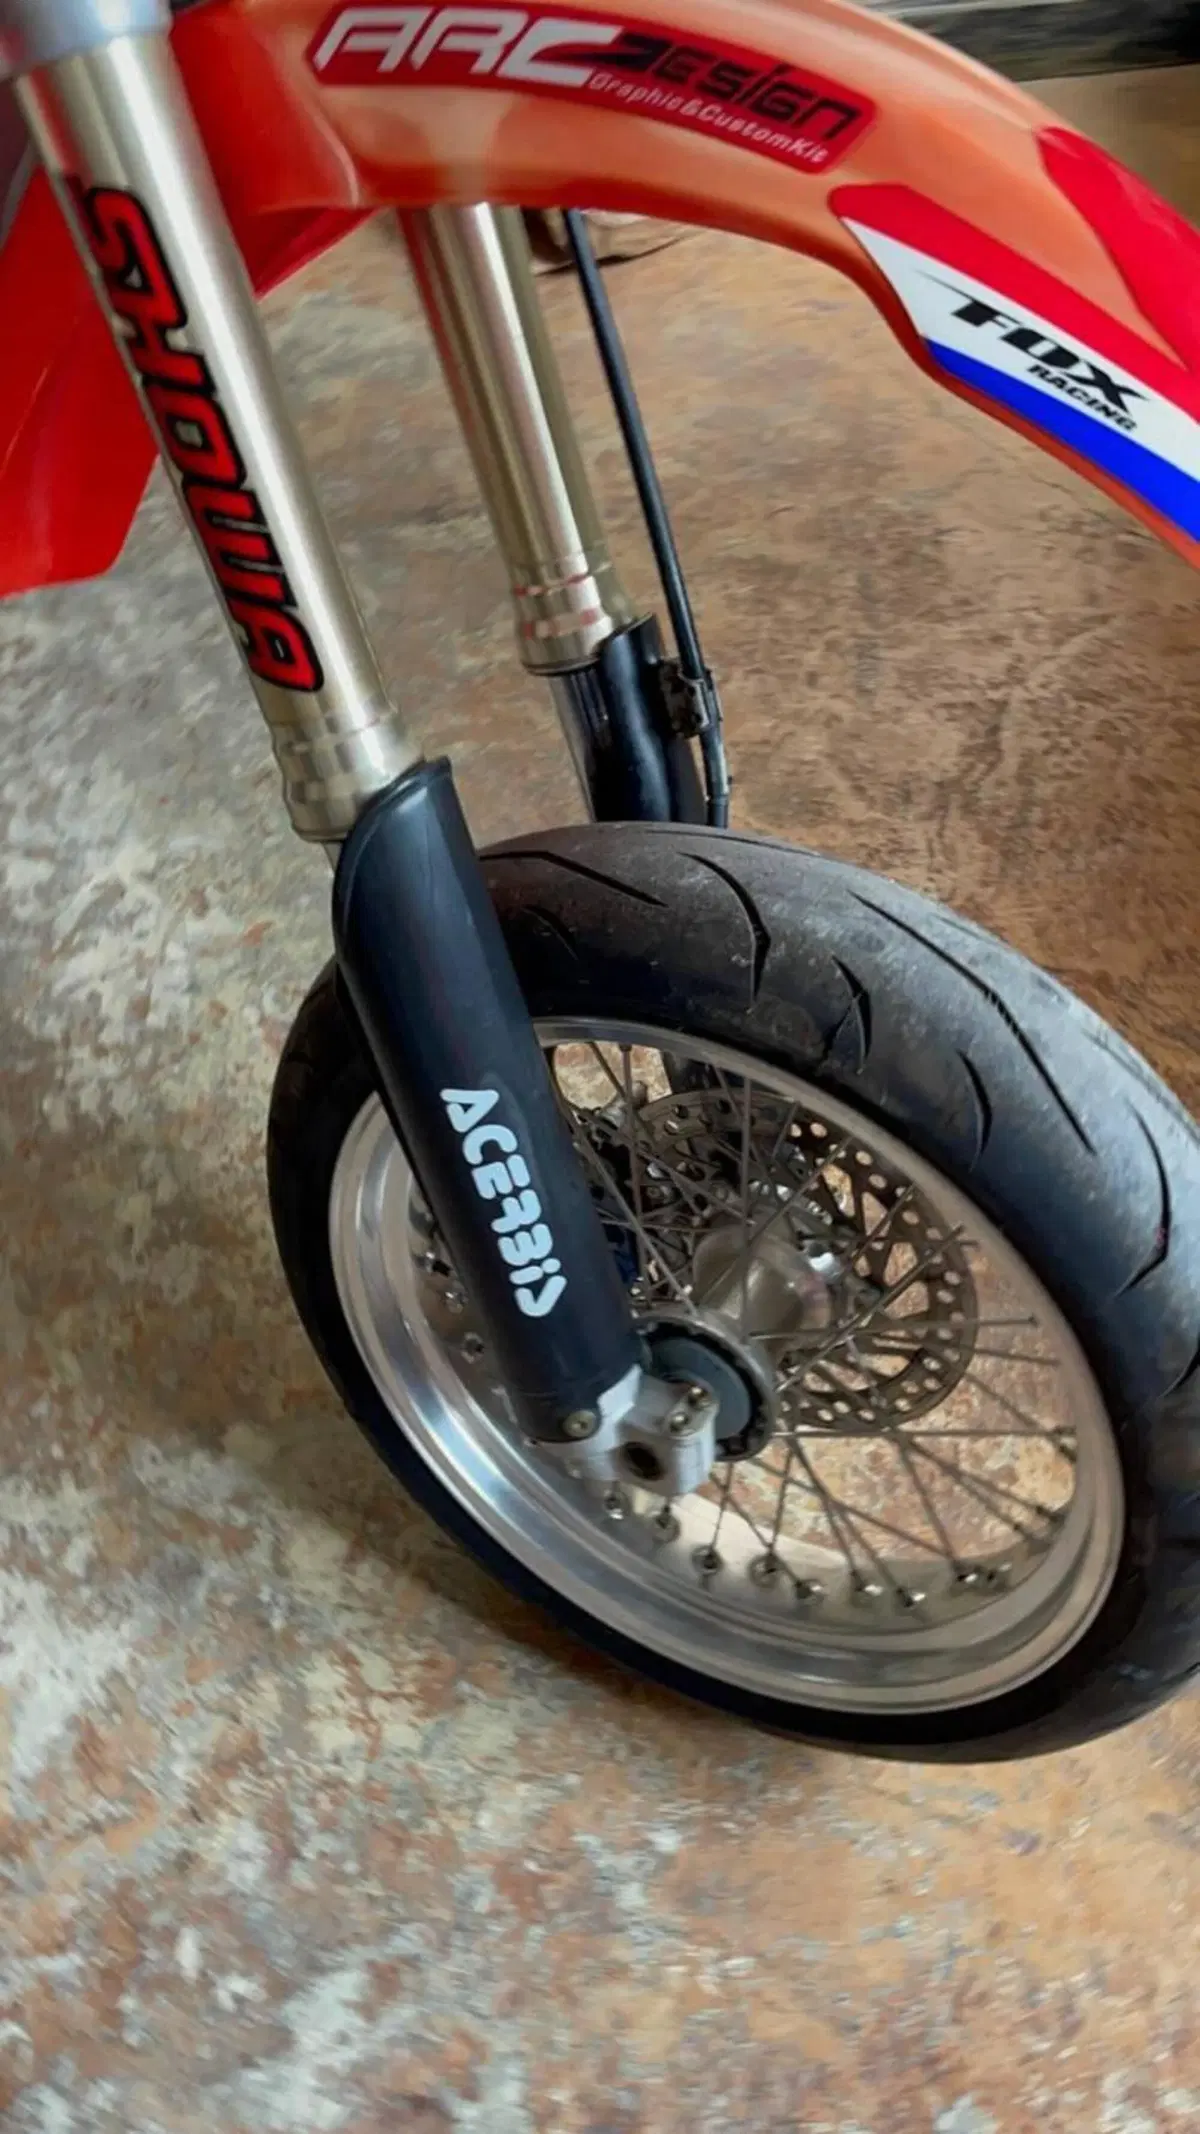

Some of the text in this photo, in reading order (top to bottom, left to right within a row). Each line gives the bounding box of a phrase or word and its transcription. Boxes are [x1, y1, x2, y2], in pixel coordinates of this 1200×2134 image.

[313, 6, 622, 87] ARC
[922, 274, 1150, 414] FOX
[1027, 362, 1138, 432] RACING
[66, 174, 325, 692] SHOWA
